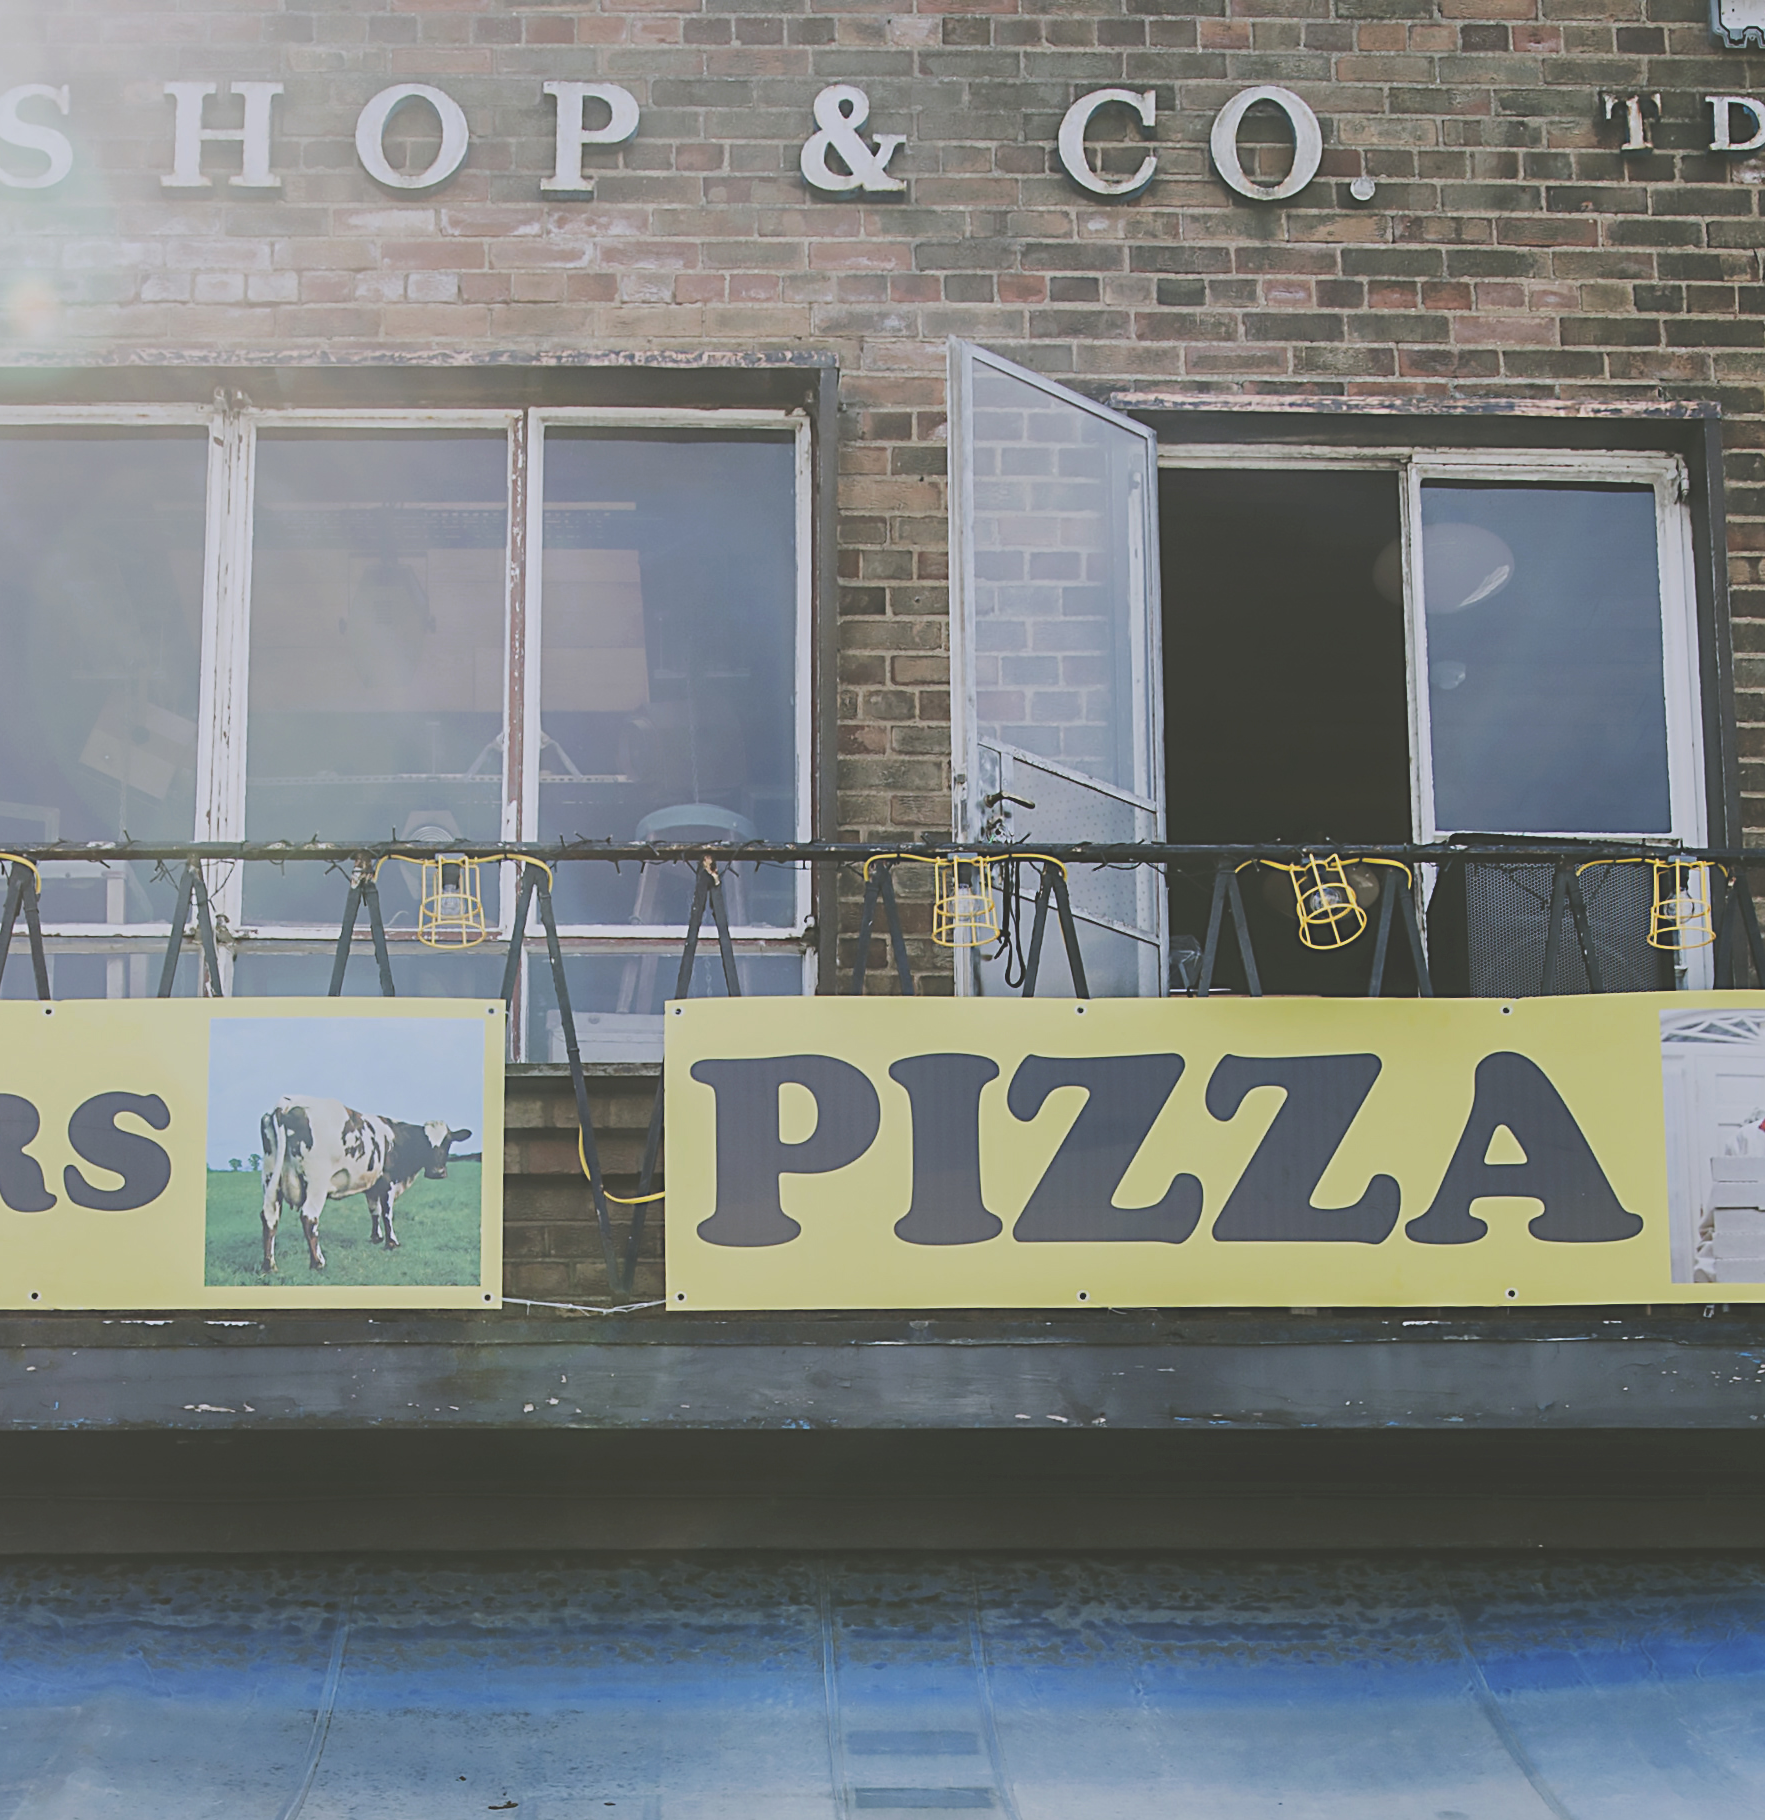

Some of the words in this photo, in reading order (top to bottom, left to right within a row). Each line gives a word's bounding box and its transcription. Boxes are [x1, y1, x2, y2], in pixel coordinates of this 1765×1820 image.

[799, 83, 909, 193] &
[1056, 83, 1377, 201] CO.
[688, 1050, 1644, 1249] PIZZA
